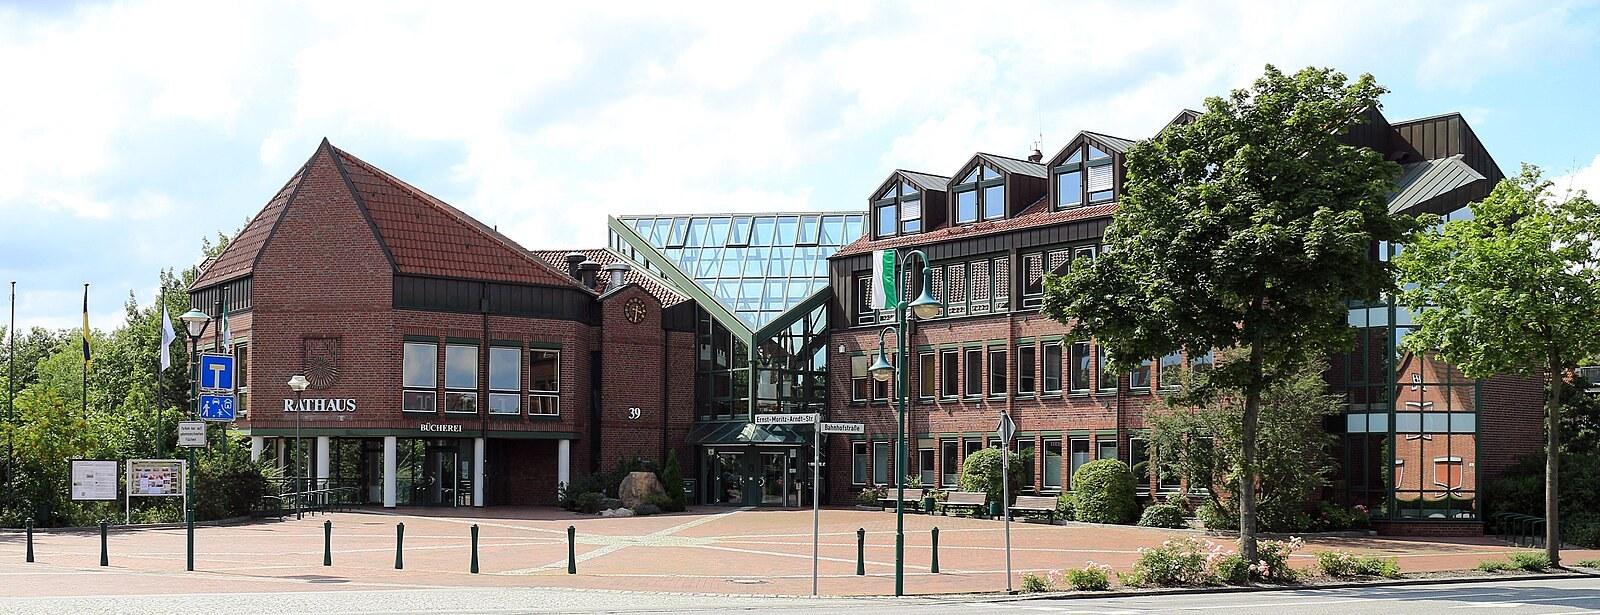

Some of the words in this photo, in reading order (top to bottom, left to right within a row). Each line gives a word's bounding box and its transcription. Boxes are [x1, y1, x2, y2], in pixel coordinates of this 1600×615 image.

[283, 398, 357, 412] RATHAUS
[628, 407, 641, 419] 39
[420, 422, 462, 432] BÜCHEREI
